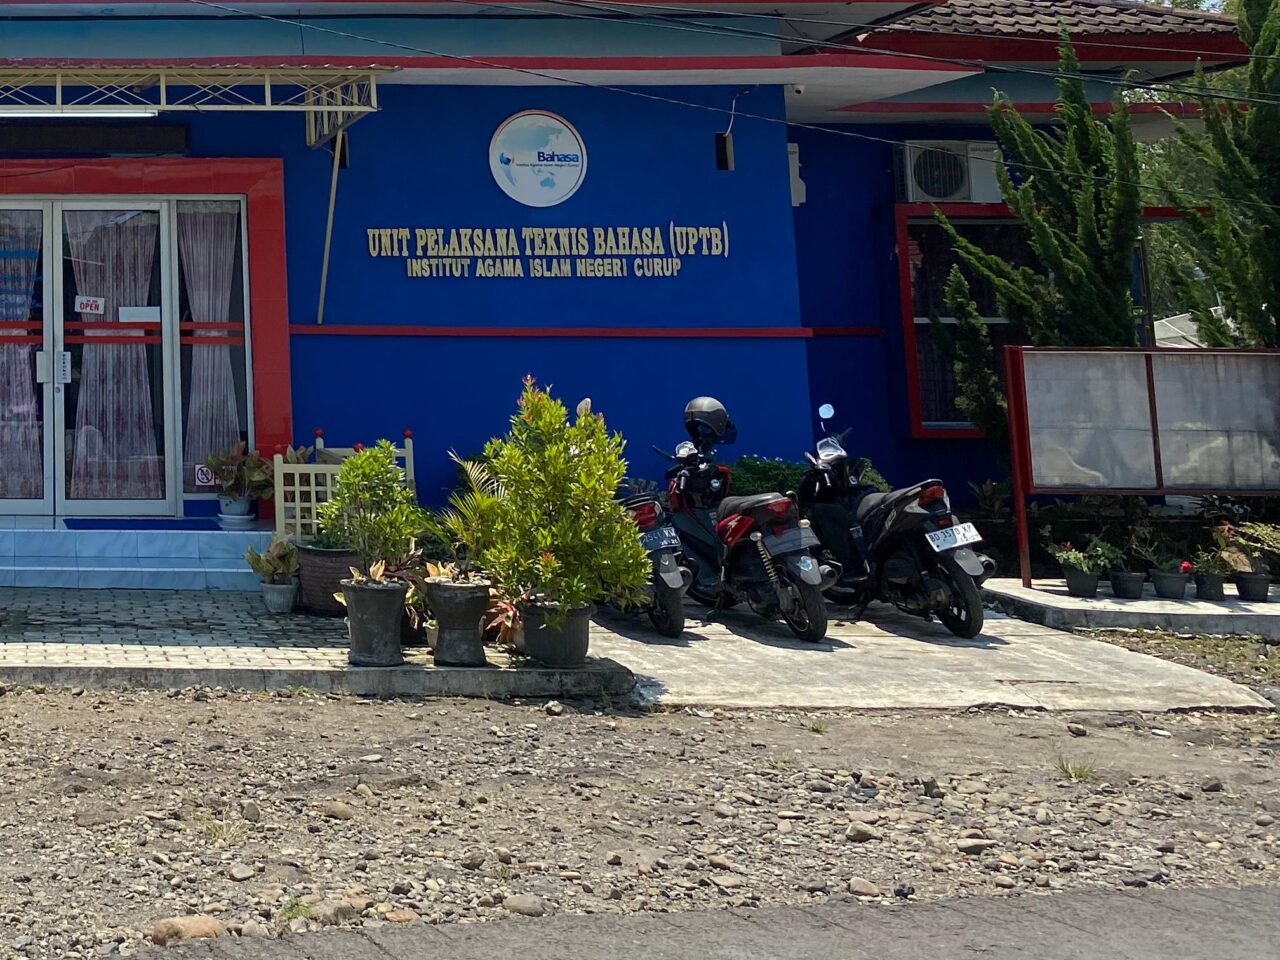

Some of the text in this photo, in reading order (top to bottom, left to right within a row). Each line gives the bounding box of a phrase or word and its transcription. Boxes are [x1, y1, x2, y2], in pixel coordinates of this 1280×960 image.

[537, 151, 579, 162] Bahasa
[367, 220, 729, 258] UNIT PELAKSANA TEKNIS BAHASA (UPTB)
[407, 258, 681, 277] INSTITUT AGAMA ISLAM NEGERI CURUP
[80, 302, 100, 311] OPEN
